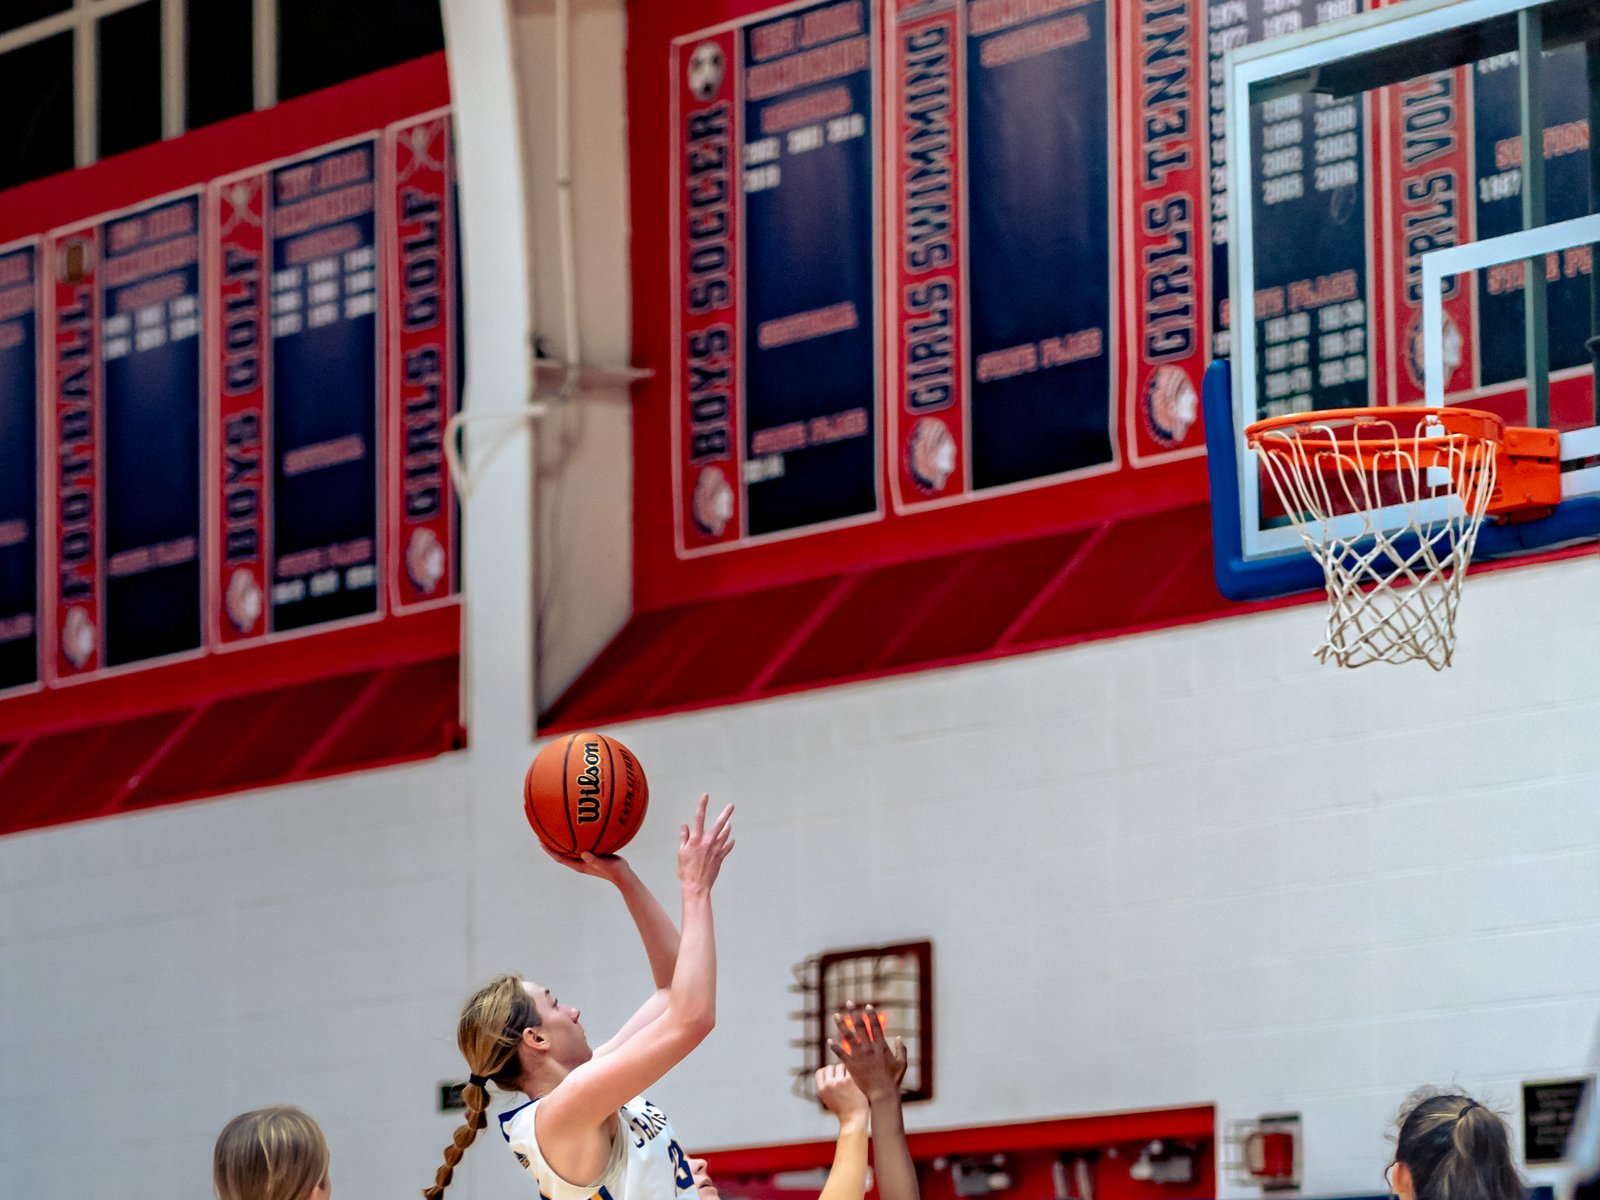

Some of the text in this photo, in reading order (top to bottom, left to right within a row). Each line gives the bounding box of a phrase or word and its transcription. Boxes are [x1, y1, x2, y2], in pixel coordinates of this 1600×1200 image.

[689, 104, 730, 463] BOYS SOCCER
[905, 26, 953, 413] GIRLS SWIMMING
[1145, 0, 1194, 361] GIRLS TENNI
[60, 289, 92, 601] FOOTBALL
[225, 246, 260, 561] BOYS GOLF
[402, 190, 441, 521] GIRLS GOLF
[577, 742, 600, 825] Wilson
